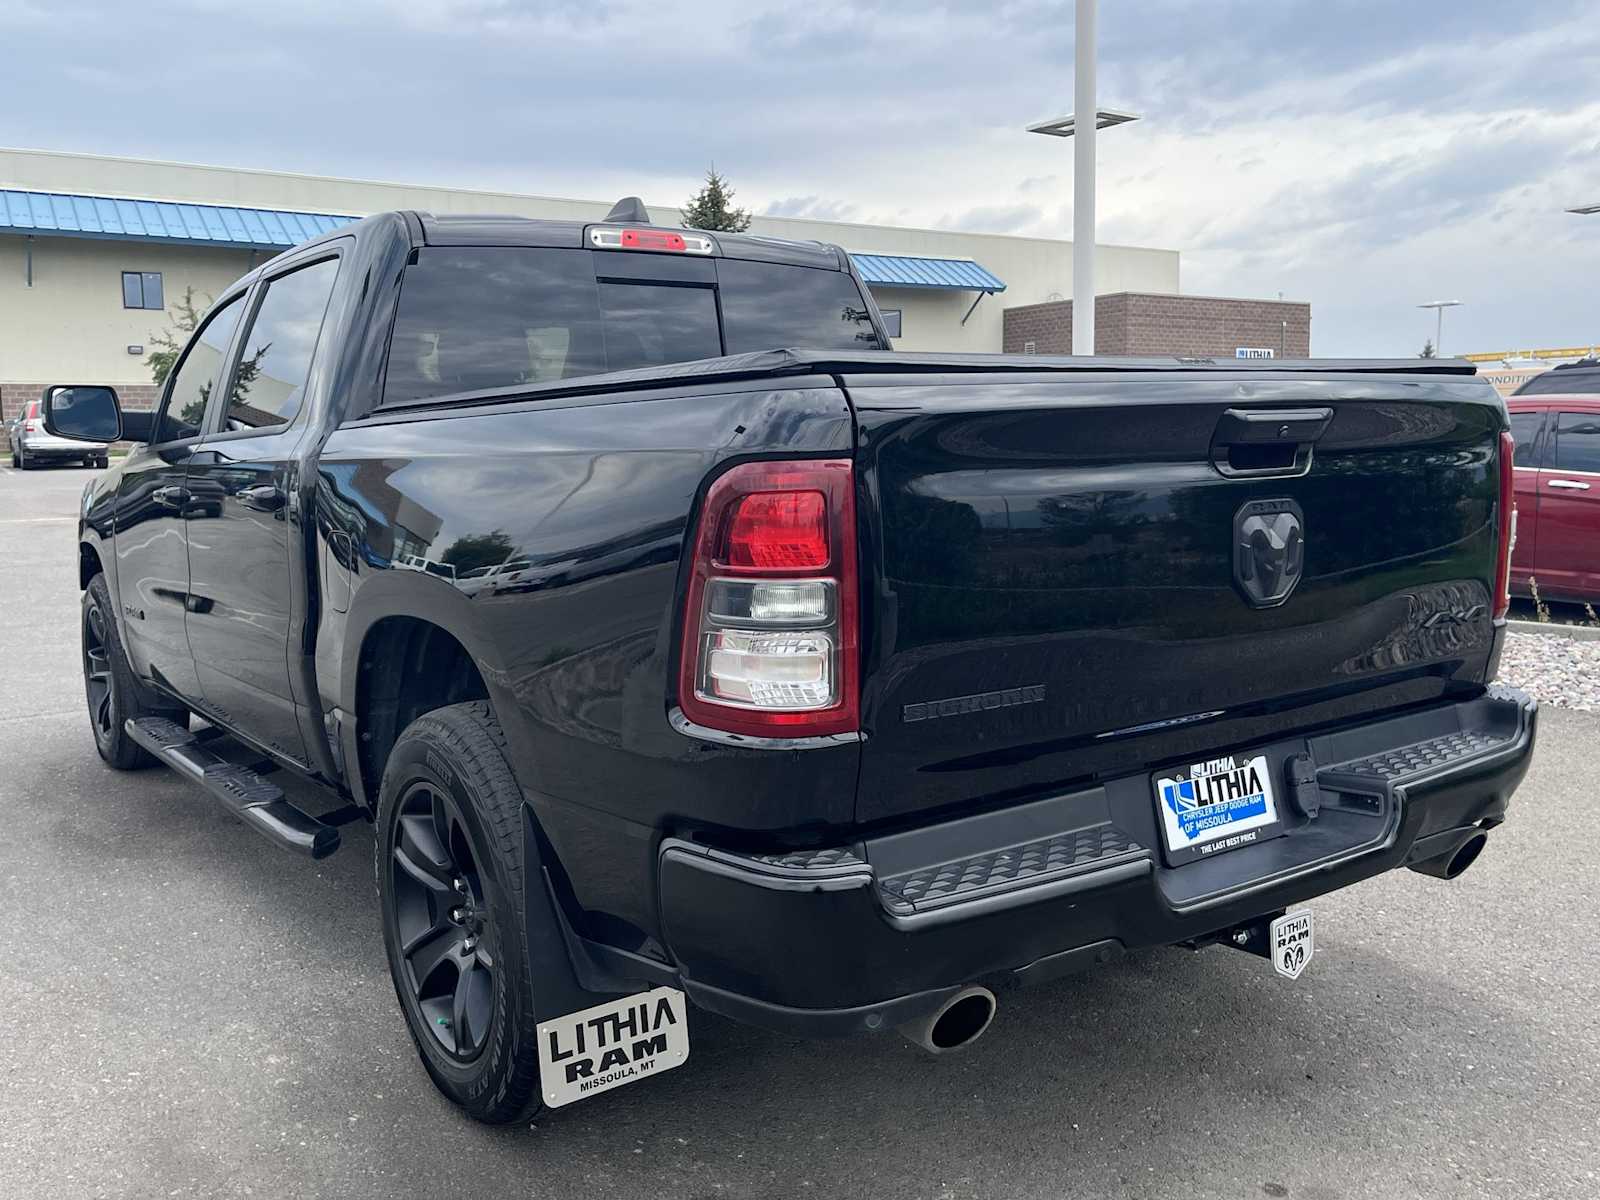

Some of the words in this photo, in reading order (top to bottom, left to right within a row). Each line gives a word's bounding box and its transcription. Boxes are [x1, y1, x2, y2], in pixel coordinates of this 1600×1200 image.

[1200, 756, 1236, 775] LITHIA
[1194, 767, 1264, 808] LITHIA
[1183, 807, 1213, 821] CHRYSLER
[1214, 803, 1229, 814] JEEP
[1229, 799, 1249, 810] DODGE
[1249, 794, 1262, 805] RAM
[1184, 821, 1195, 833] OF
[1196, 812, 1233, 830] MISSOULA
[1200, 844, 1213, 855] THE
[1212, 840, 1226, 851] LAST
[1226, 835, 1240, 847] BEST
[1240, 832, 1257, 843] PRICE
[1278, 918, 1308, 938] LITHIA
[1278, 929, 1309, 948] RAM
[549, 997, 677, 1063] LITHIA
[565, 1033, 668, 1084] RAM
[580, 1066, 638, 1093] MISSOULA,
[640, 1059, 656, 1072] MT
